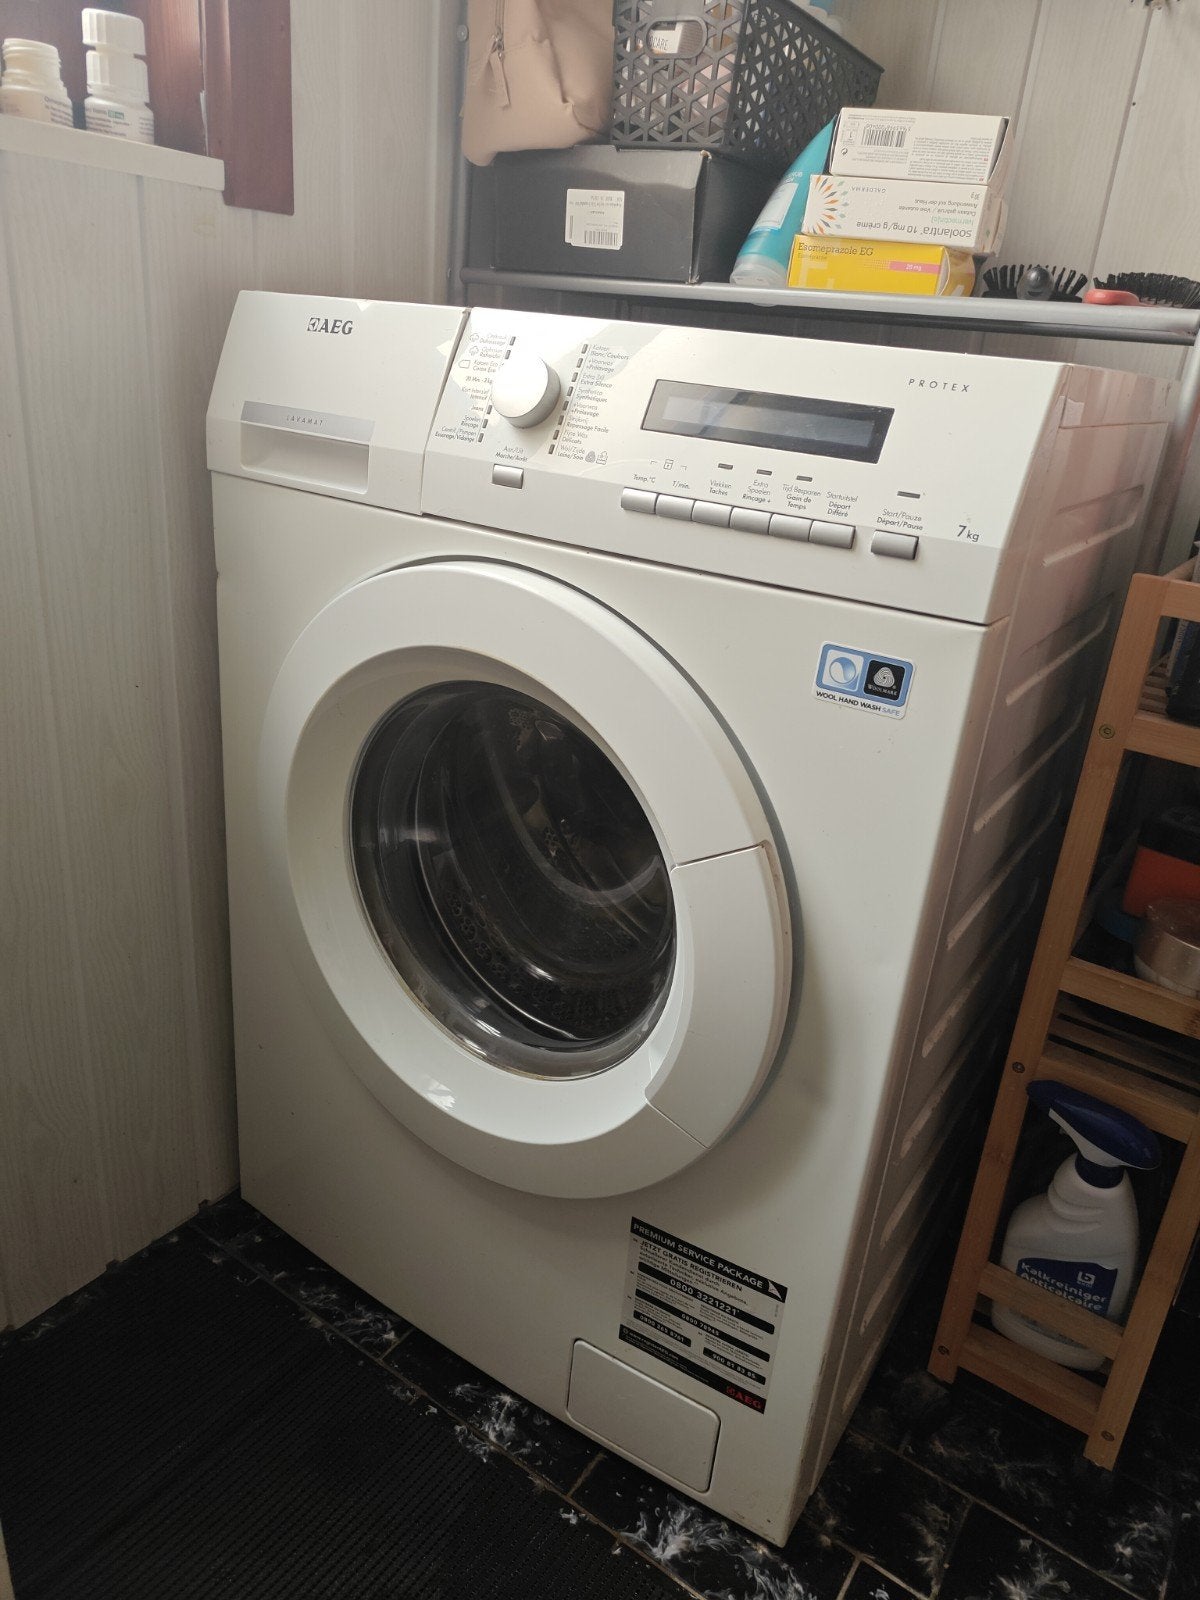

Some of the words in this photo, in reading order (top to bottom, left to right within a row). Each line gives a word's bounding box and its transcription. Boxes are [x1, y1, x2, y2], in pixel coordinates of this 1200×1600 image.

[851, 186, 886, 194] GALDERMA
[882, 222, 906, 232] mg/g
[906, 225, 918, 234] 10
[798, 243, 857, 256] Esomeprazole
[860, 246, 874, 256] EG
[318, 318, 353, 335] AEG
[908, 378, 970, 392] PROTEX
[286, 415, 323, 426] LAVAMAT
[672, 481, 690, 490] T/min.
[710, 480, 732, 489] Vlekken
[753, 480, 769, 488] Extra
[709, 488, 728, 496] Taches
[748, 486, 770, 496] Spoelen
[783, 484, 792, 492] Tijd
[794, 486, 822, 497] Besparen
[742, 494, 766, 504] Rinçage
[786, 494, 801, 502] Gain
[802, 496, 812, 504] de
[828, 500, 851, 510] Départ
[788, 502, 806, 511] Temps
[828, 508, 849, 518] Différé
[882, 508, 922, 522] Start/Pauze
[876, 516, 923, 531] Départ/Pause
[868, 684, 898, 696] WOOLMARK
[816, 690, 836, 701] WOOL
[838, 697, 858, 706] HAND
[860, 702, 880, 711] WASH
[882, 707, 900, 716] SAFE
[633, 1222, 675, 1248] PREMIUM
[677, 1243, 715, 1267] SERVICE
[717, 1262, 763, 1289] PACKAGE
[640, 1239, 660, 1254] JETZT
[662, 1249, 688, 1267] GRATIS
[689, 1262, 742, 1292] REGISTRIEREN
[670, 1278, 693, 1295] 0800
[1022, 1262, 1106, 1302] Kalkreiniger
[1020, 1272, 1102, 1310] Anticalcaire
[681, 1313, 697, 1325] 0800
[735, 1390, 762, 1410] AEG
